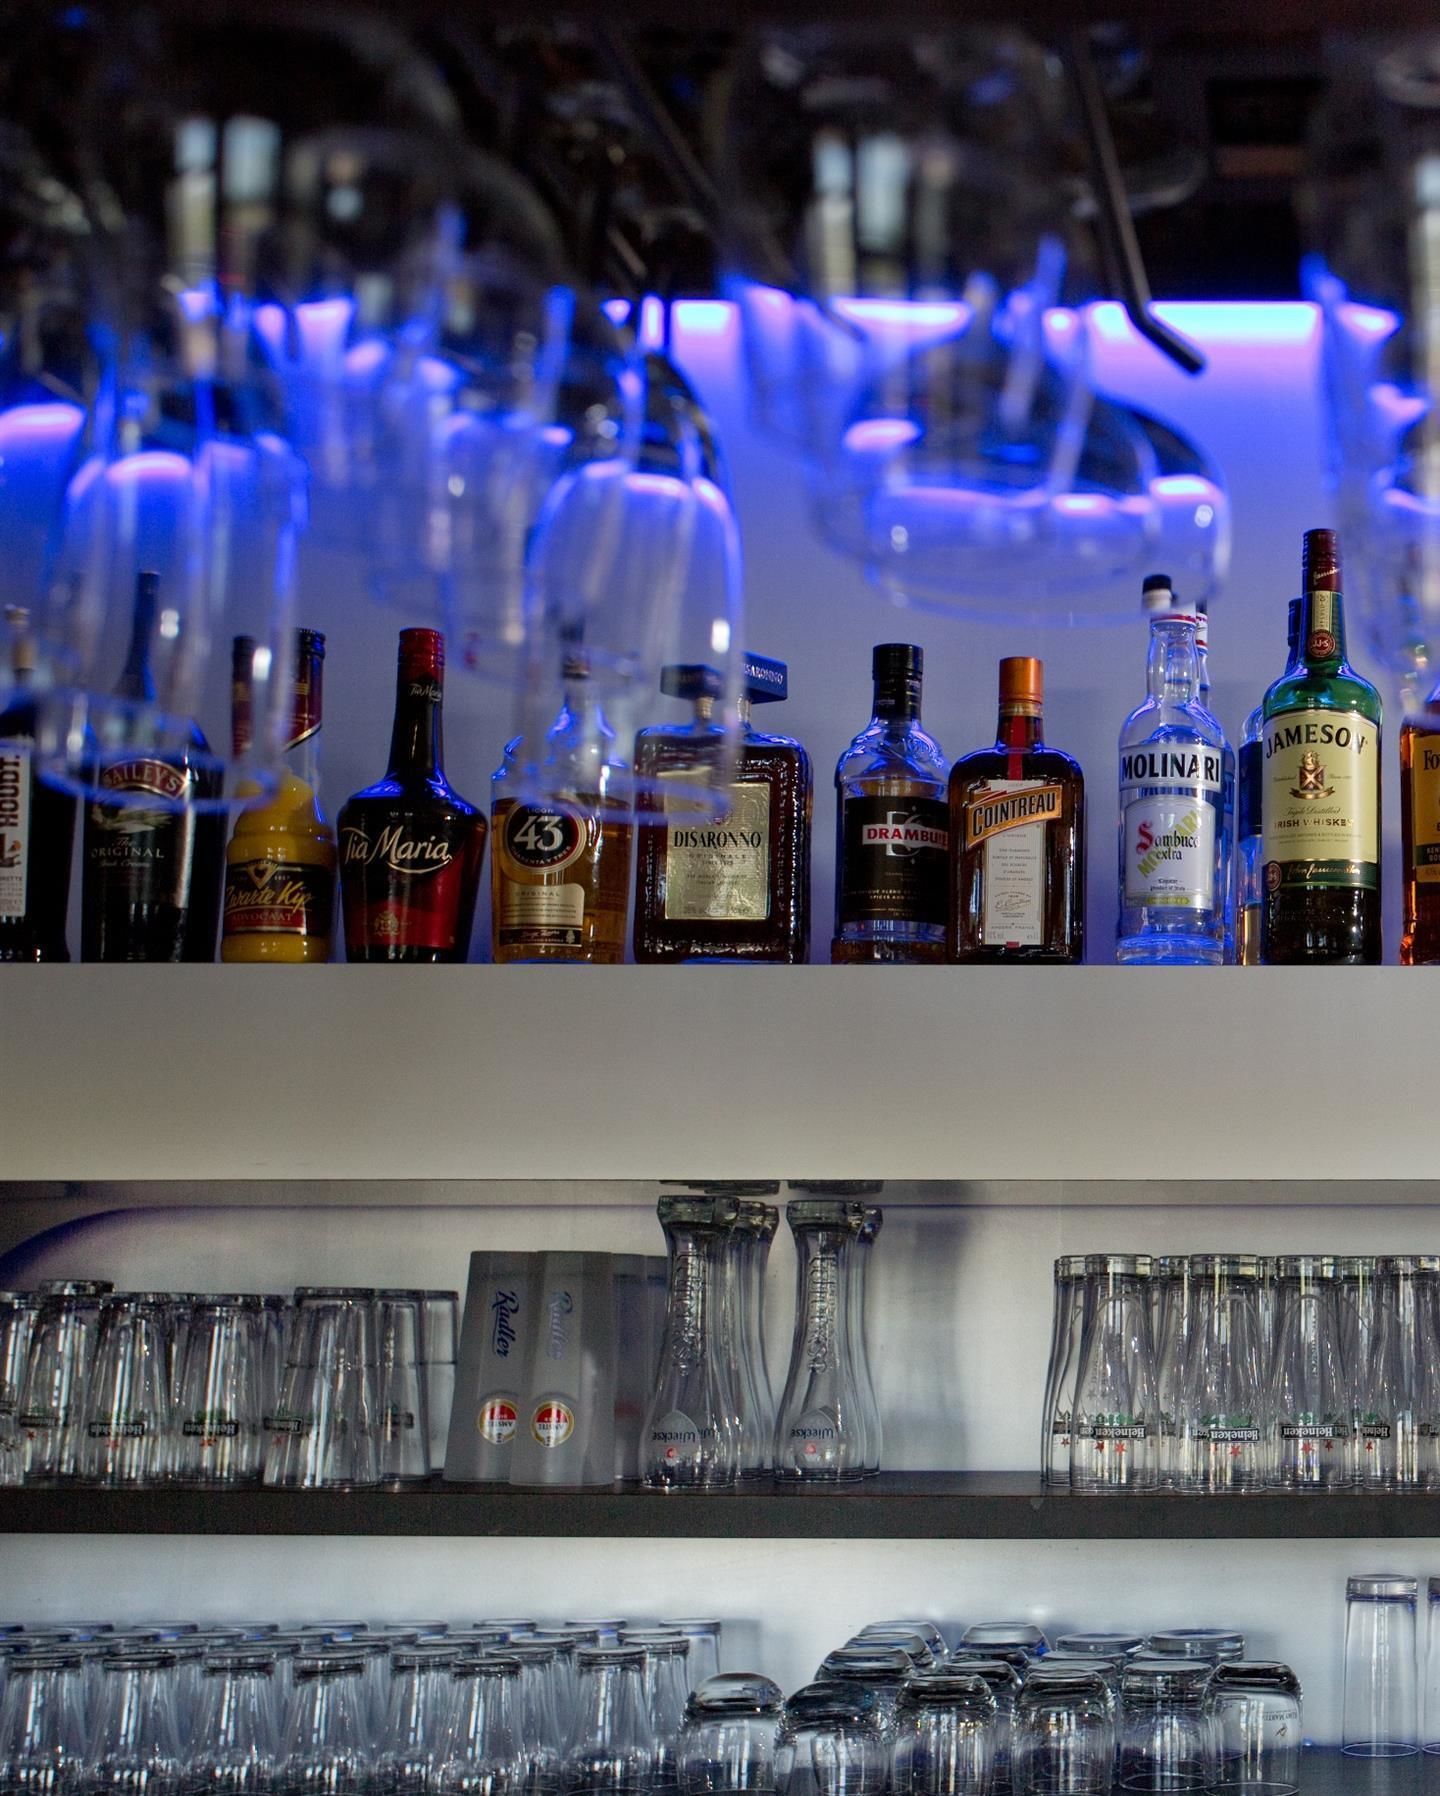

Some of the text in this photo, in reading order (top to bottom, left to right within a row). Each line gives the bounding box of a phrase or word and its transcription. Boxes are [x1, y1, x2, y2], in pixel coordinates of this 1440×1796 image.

[744, 663, 783, 685] SARONNO
[1266, 723, 1366, 759] JAMESON
[1121, 753, 1219, 782] MOLINARI
[972, 792, 1056, 837] COINTREAU
[513, 815, 564, 850] 43
[674, 831, 763, 848] DISARONNO
[342, 825, 453, 866] Tia Maria
[1095, 1427, 1145, 1437] Heineken
[1211, 1429, 1258, 1440] Heineken
[1283, 1427, 1332, 1437] Heineken
